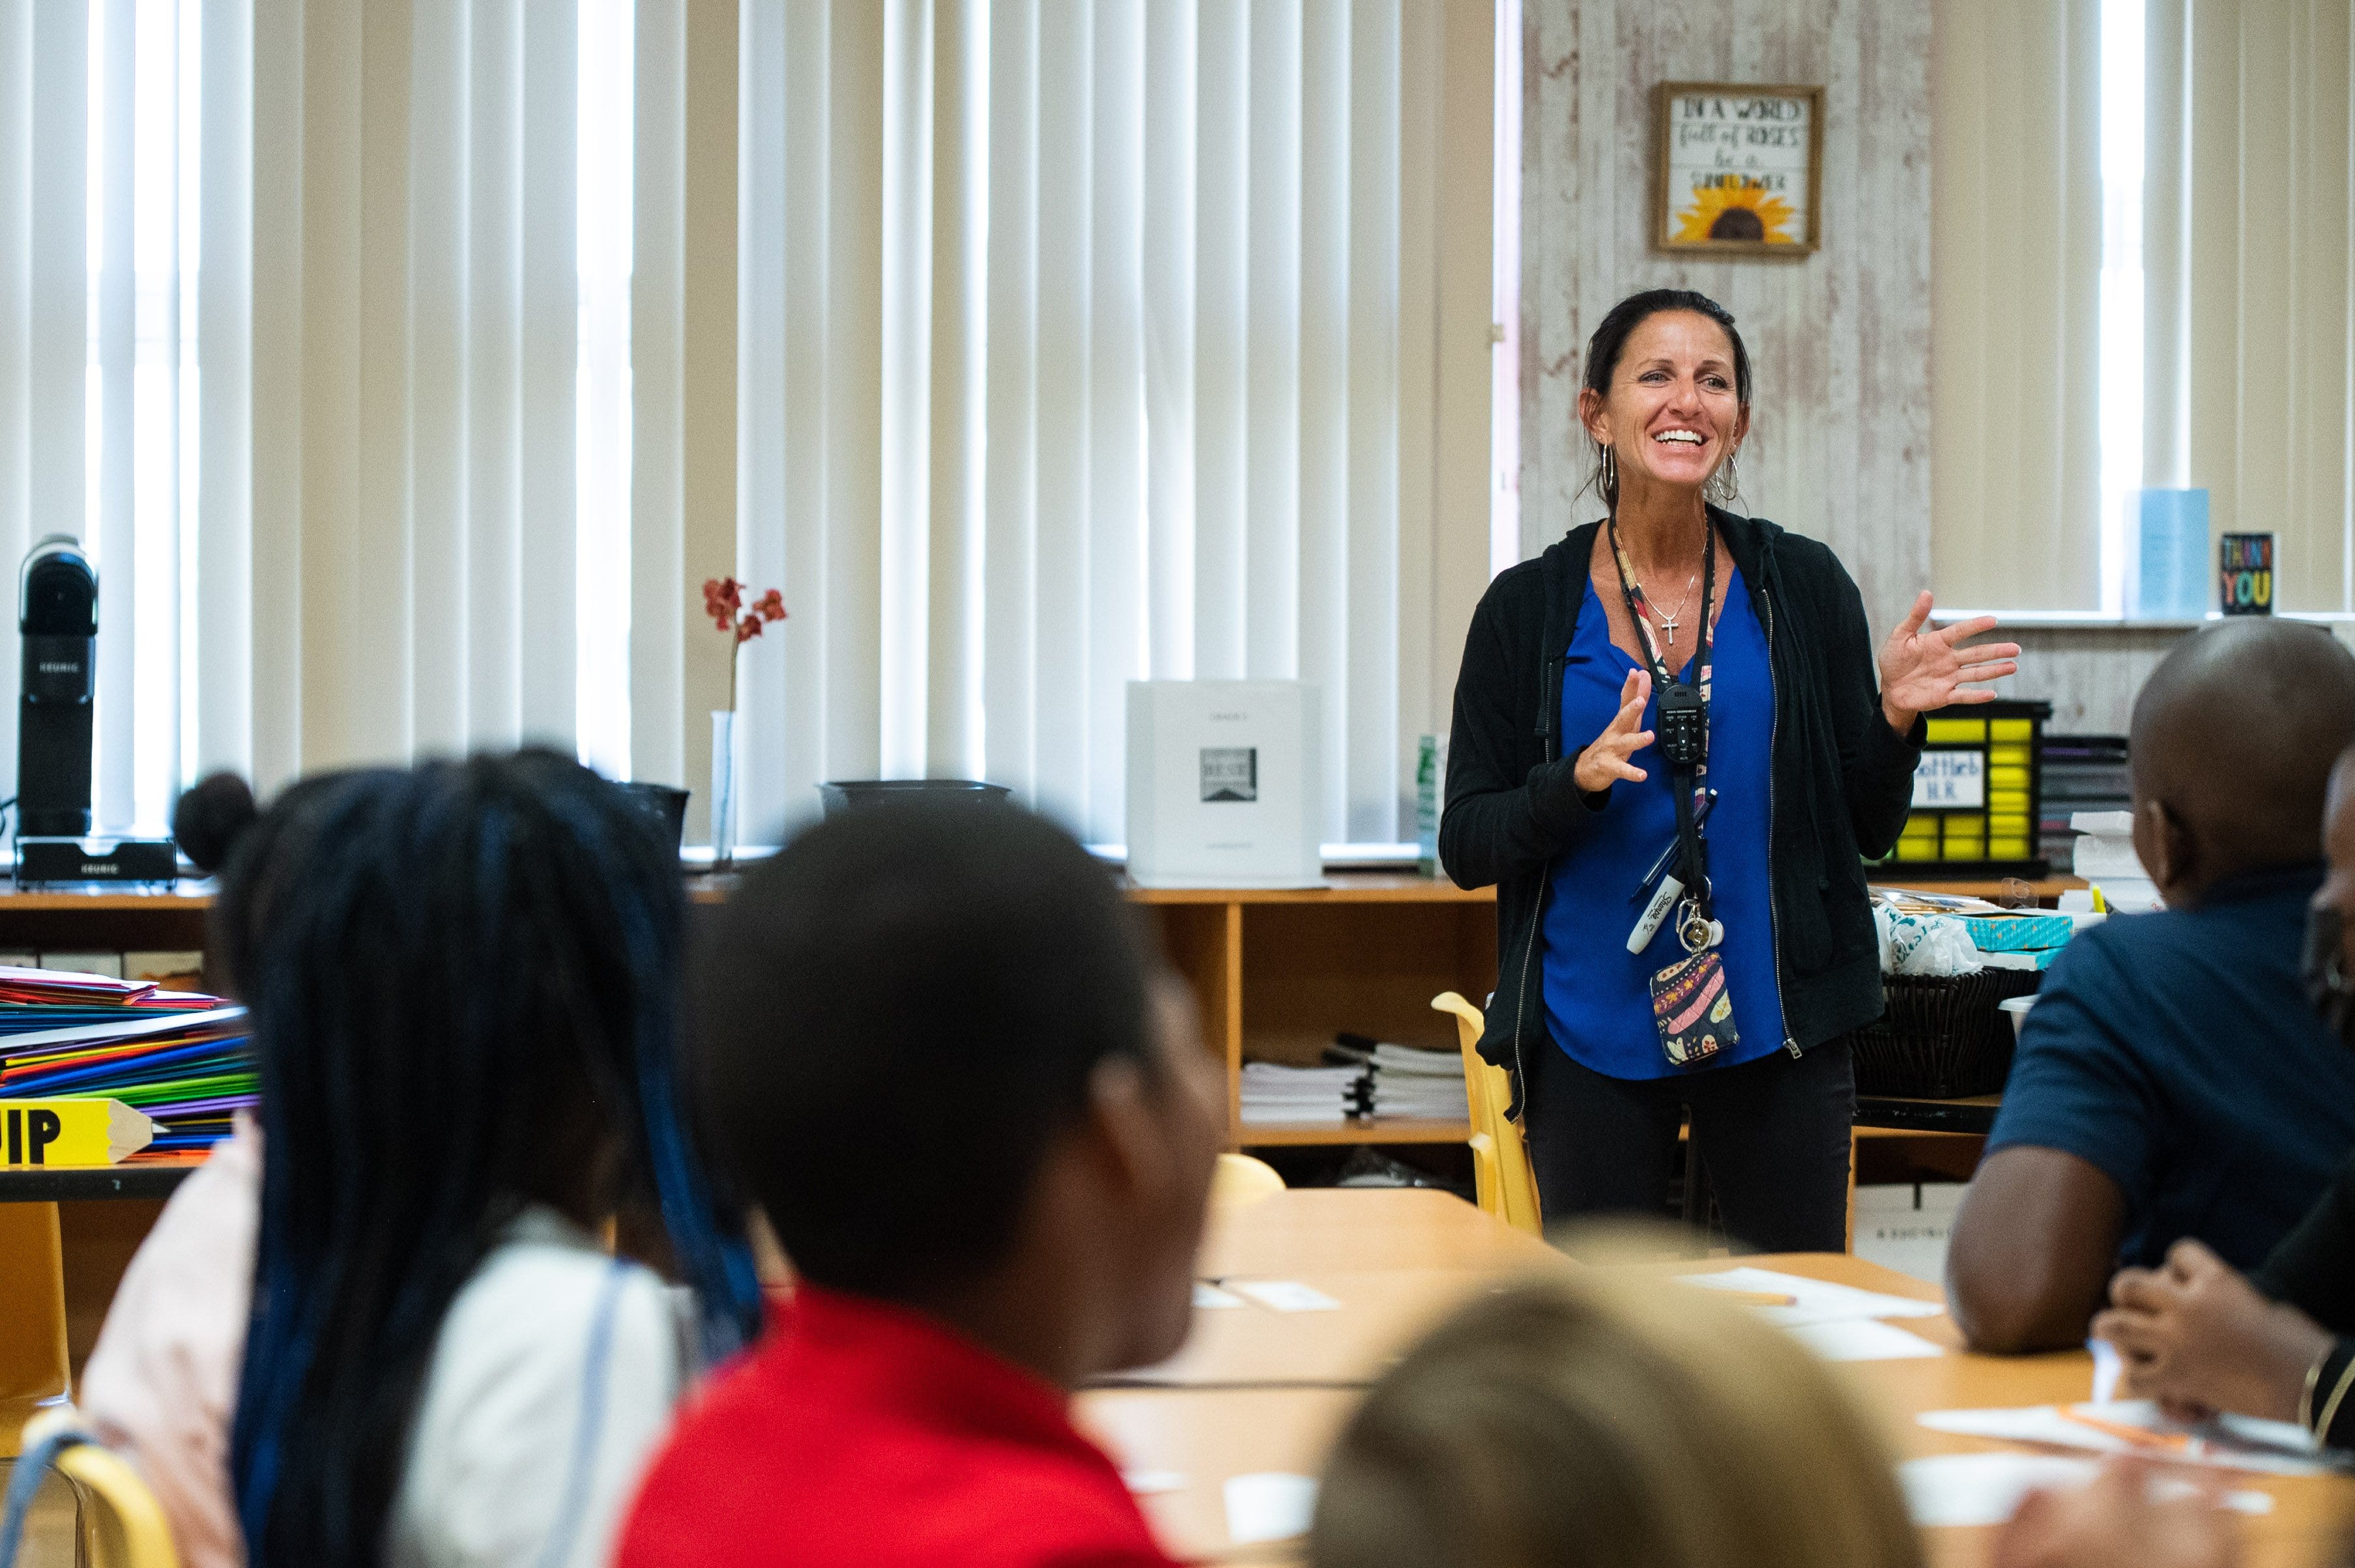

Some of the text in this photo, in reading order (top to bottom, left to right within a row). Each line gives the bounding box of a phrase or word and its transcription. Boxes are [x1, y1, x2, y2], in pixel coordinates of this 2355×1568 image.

[1712, 98, 1725, 118] A
[2222, 571, 2272, 606] YOU
[39, 662, 79, 673] KEURIG
[81, 863, 119, 874] KEURIG
[1649, 891, 1672, 920] Sharpie
[0, 1109, 61, 1165] IP
